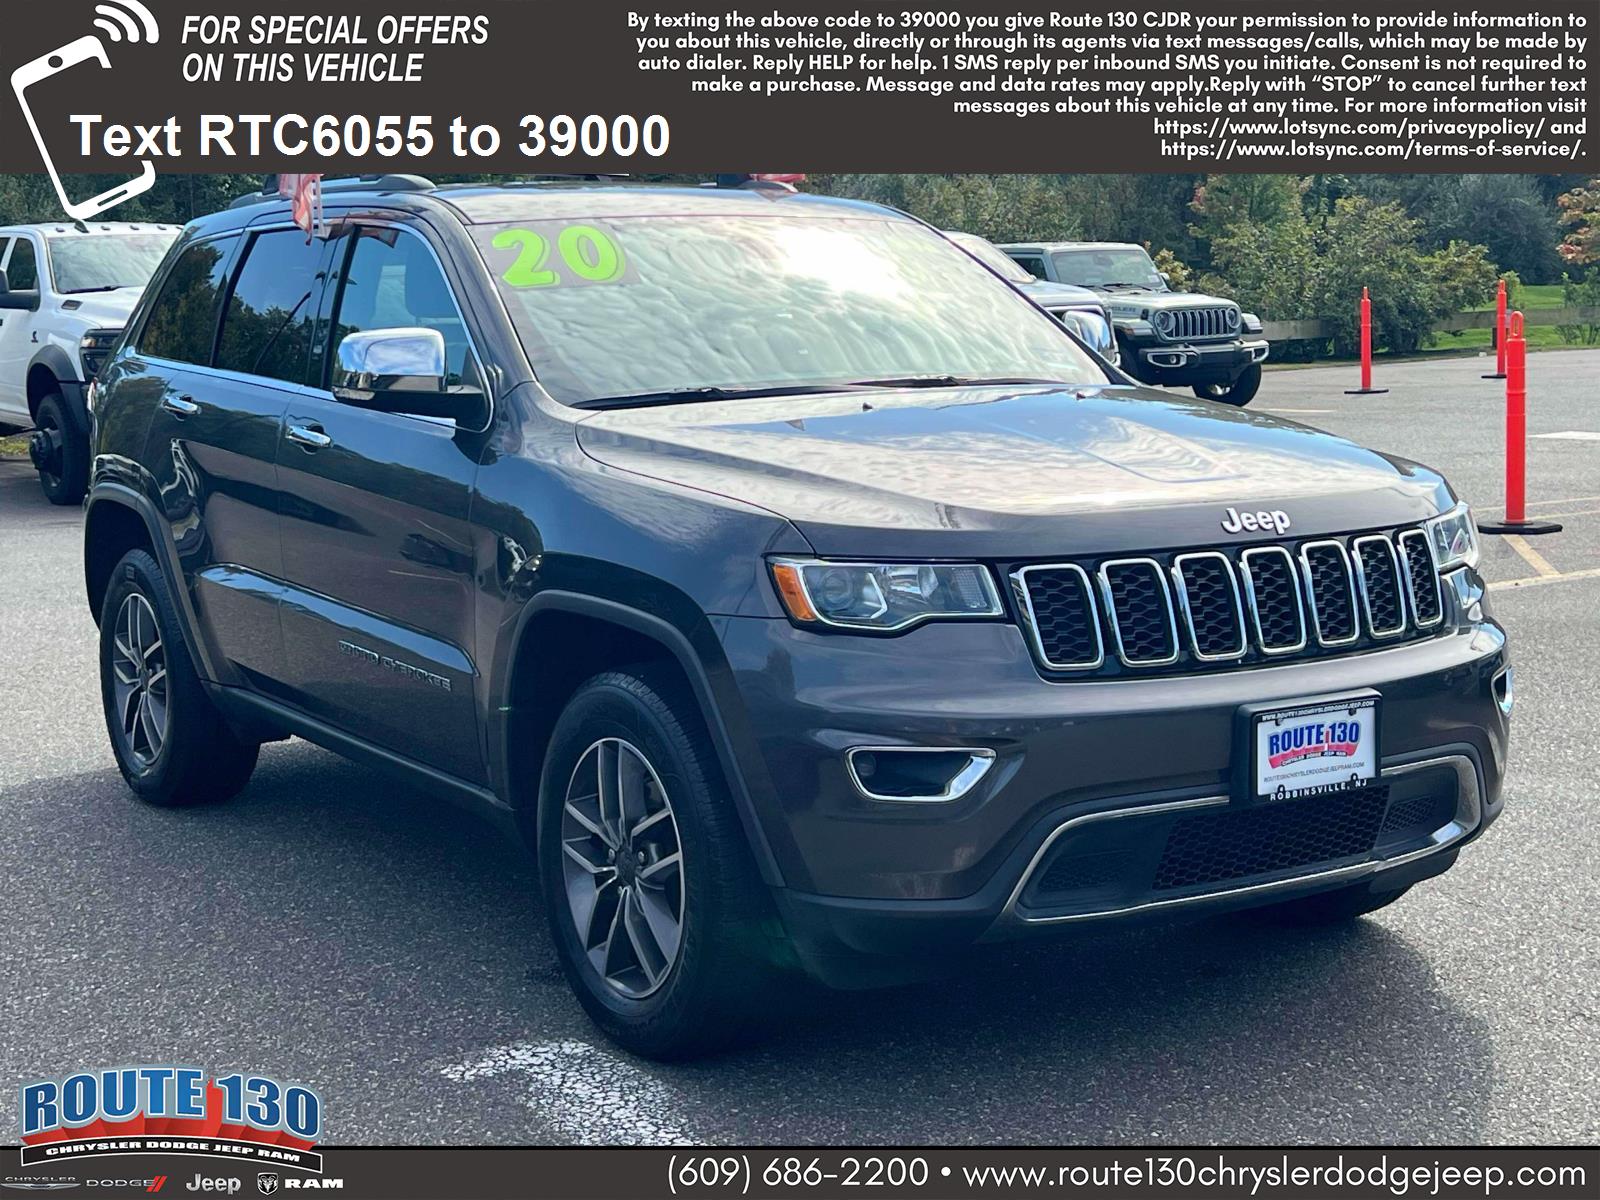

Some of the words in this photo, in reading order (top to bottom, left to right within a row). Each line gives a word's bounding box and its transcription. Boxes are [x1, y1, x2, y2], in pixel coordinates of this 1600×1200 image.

[492, 225, 626, 288] 20
[1221, 507, 1291, 535] Jeep
[1269, 724, 1325, 756] ROUTE
[1328, 721, 1360, 743] 130
[1270, 782, 1350, 801] ROBBINSVILLE,
[1355, 778, 1367, 788] NJ
